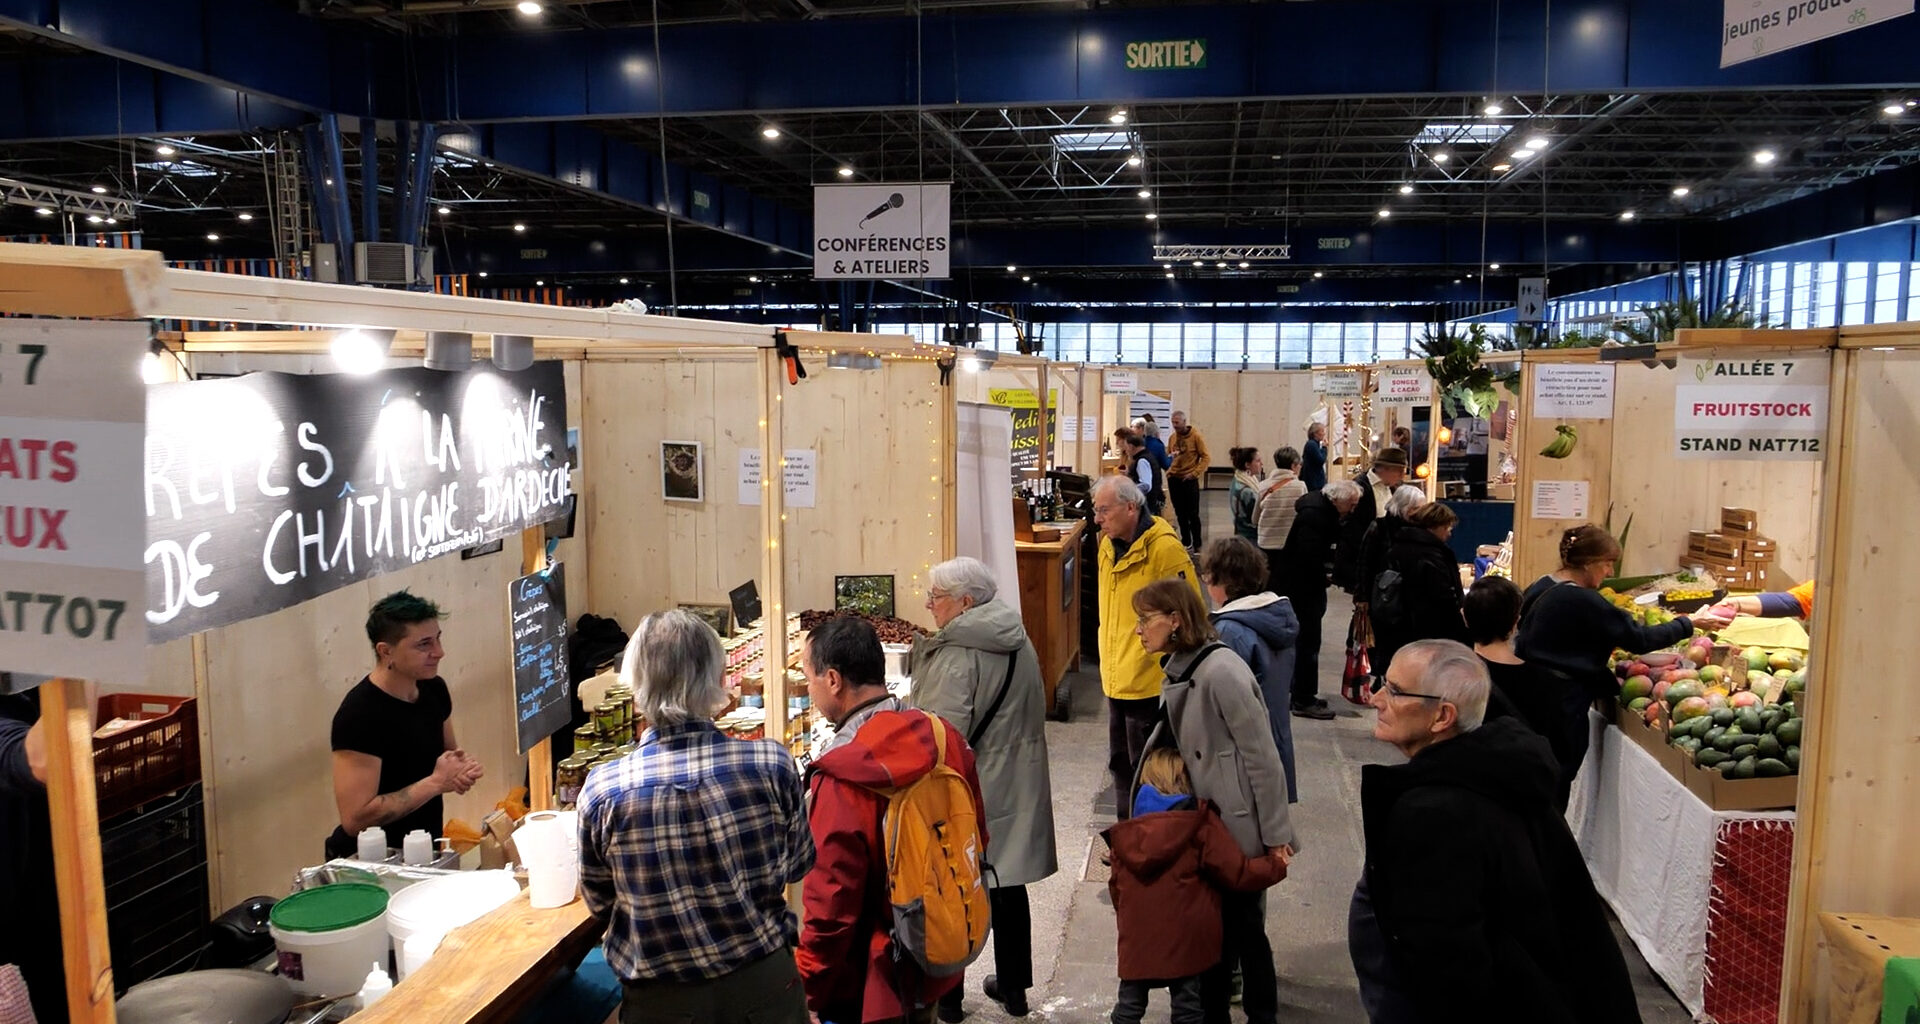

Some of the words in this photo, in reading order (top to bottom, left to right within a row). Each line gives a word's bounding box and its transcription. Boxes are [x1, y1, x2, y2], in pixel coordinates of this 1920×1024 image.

[1724, 11, 1781, 46] jeunes
[1127, 41, 1190, 68] SORTIE
[817, 233, 947, 252] CONFÉRENCES
[833, 260, 846, 274] &
[851, 260, 930, 274] ATELIERS
[18, 344, 47, 385] 7
[1715, 358, 1775, 376] ALLÉE
[1782, 362, 1794, 376] 7
[1693, 403, 1812, 416] FRUITSTOCK
[422, 409, 461, 473] LA
[1680, 438, 1742, 451] STAND
[1748, 438, 1820, 452] NAT712
[0, 506, 68, 551] UX
[143, 531, 220, 625] DE
[0, 591, 127, 641] T707
